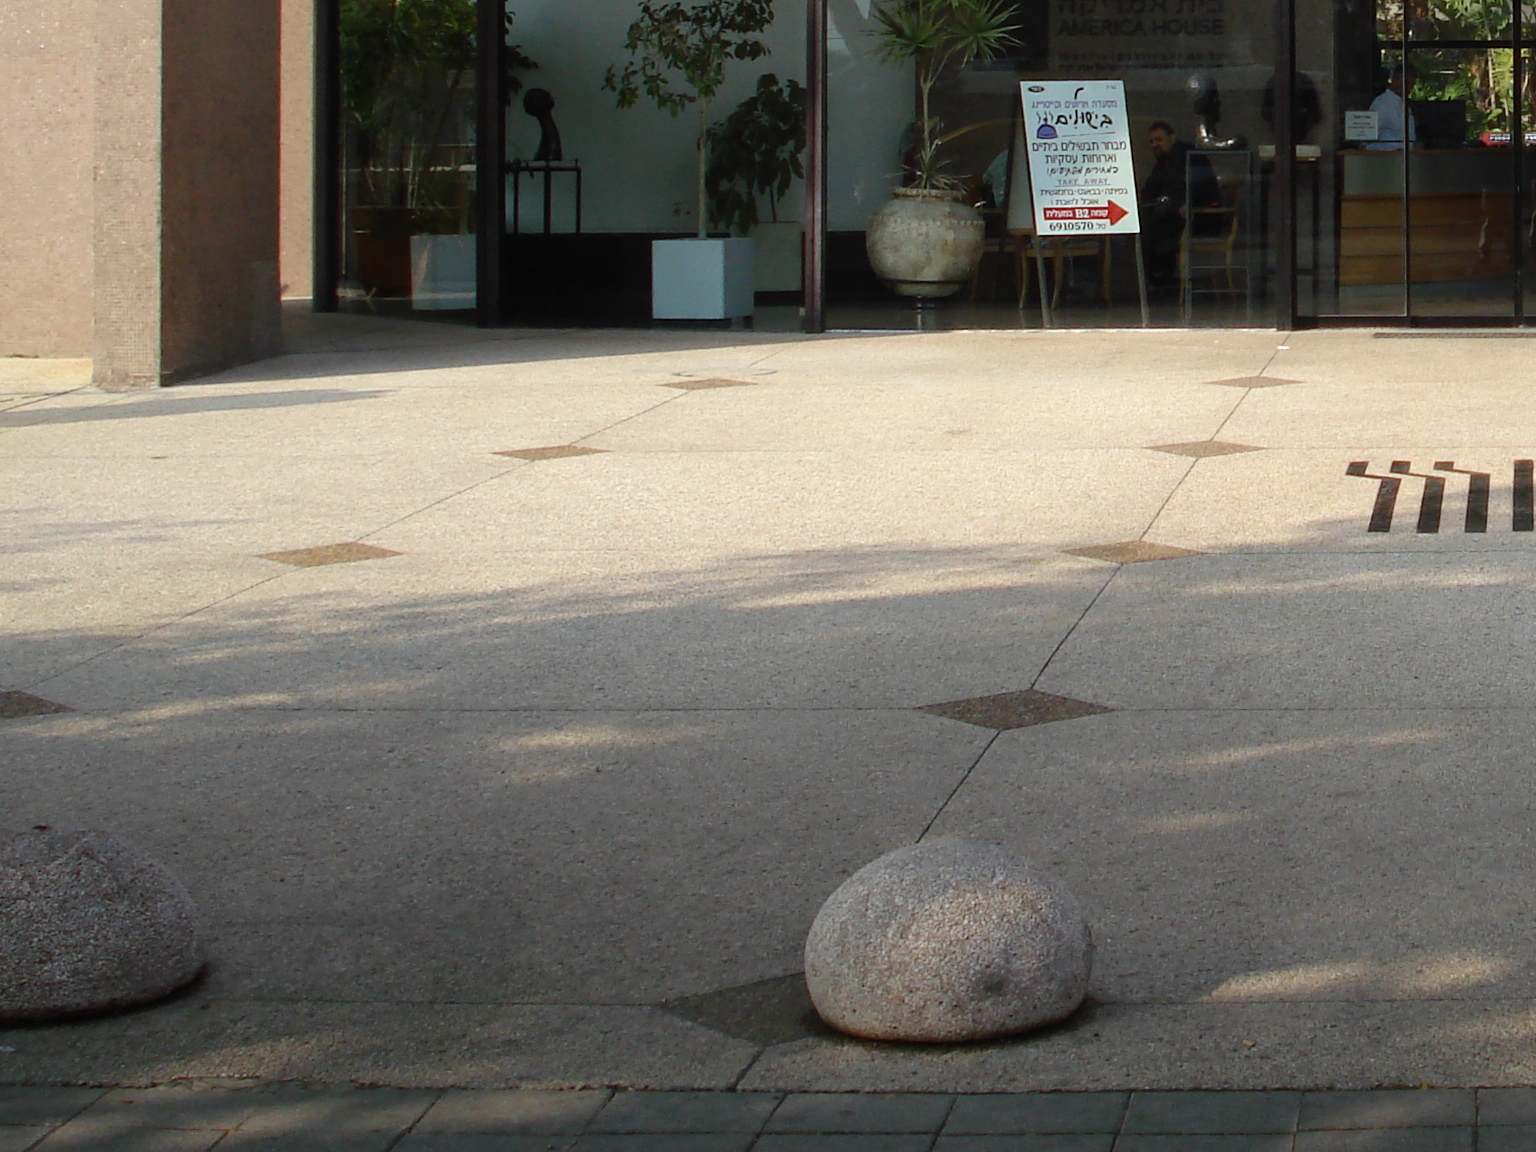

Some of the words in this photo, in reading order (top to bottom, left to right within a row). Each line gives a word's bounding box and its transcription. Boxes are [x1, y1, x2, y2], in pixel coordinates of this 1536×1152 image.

[1057, 18, 1147, 36] AMERICA
[1152, 18, 1224, 36] HOUSE
[1061, 140, 1099, 151] תבשילים
[1101, 141, 1127, 150] מבחר
[1045, 154, 1078, 166] עסקיות
[1057, 178, 1078, 186] TAKE
[1075, 209, 1090, 218] B2
[1049, 221, 1094, 231] 6910570
